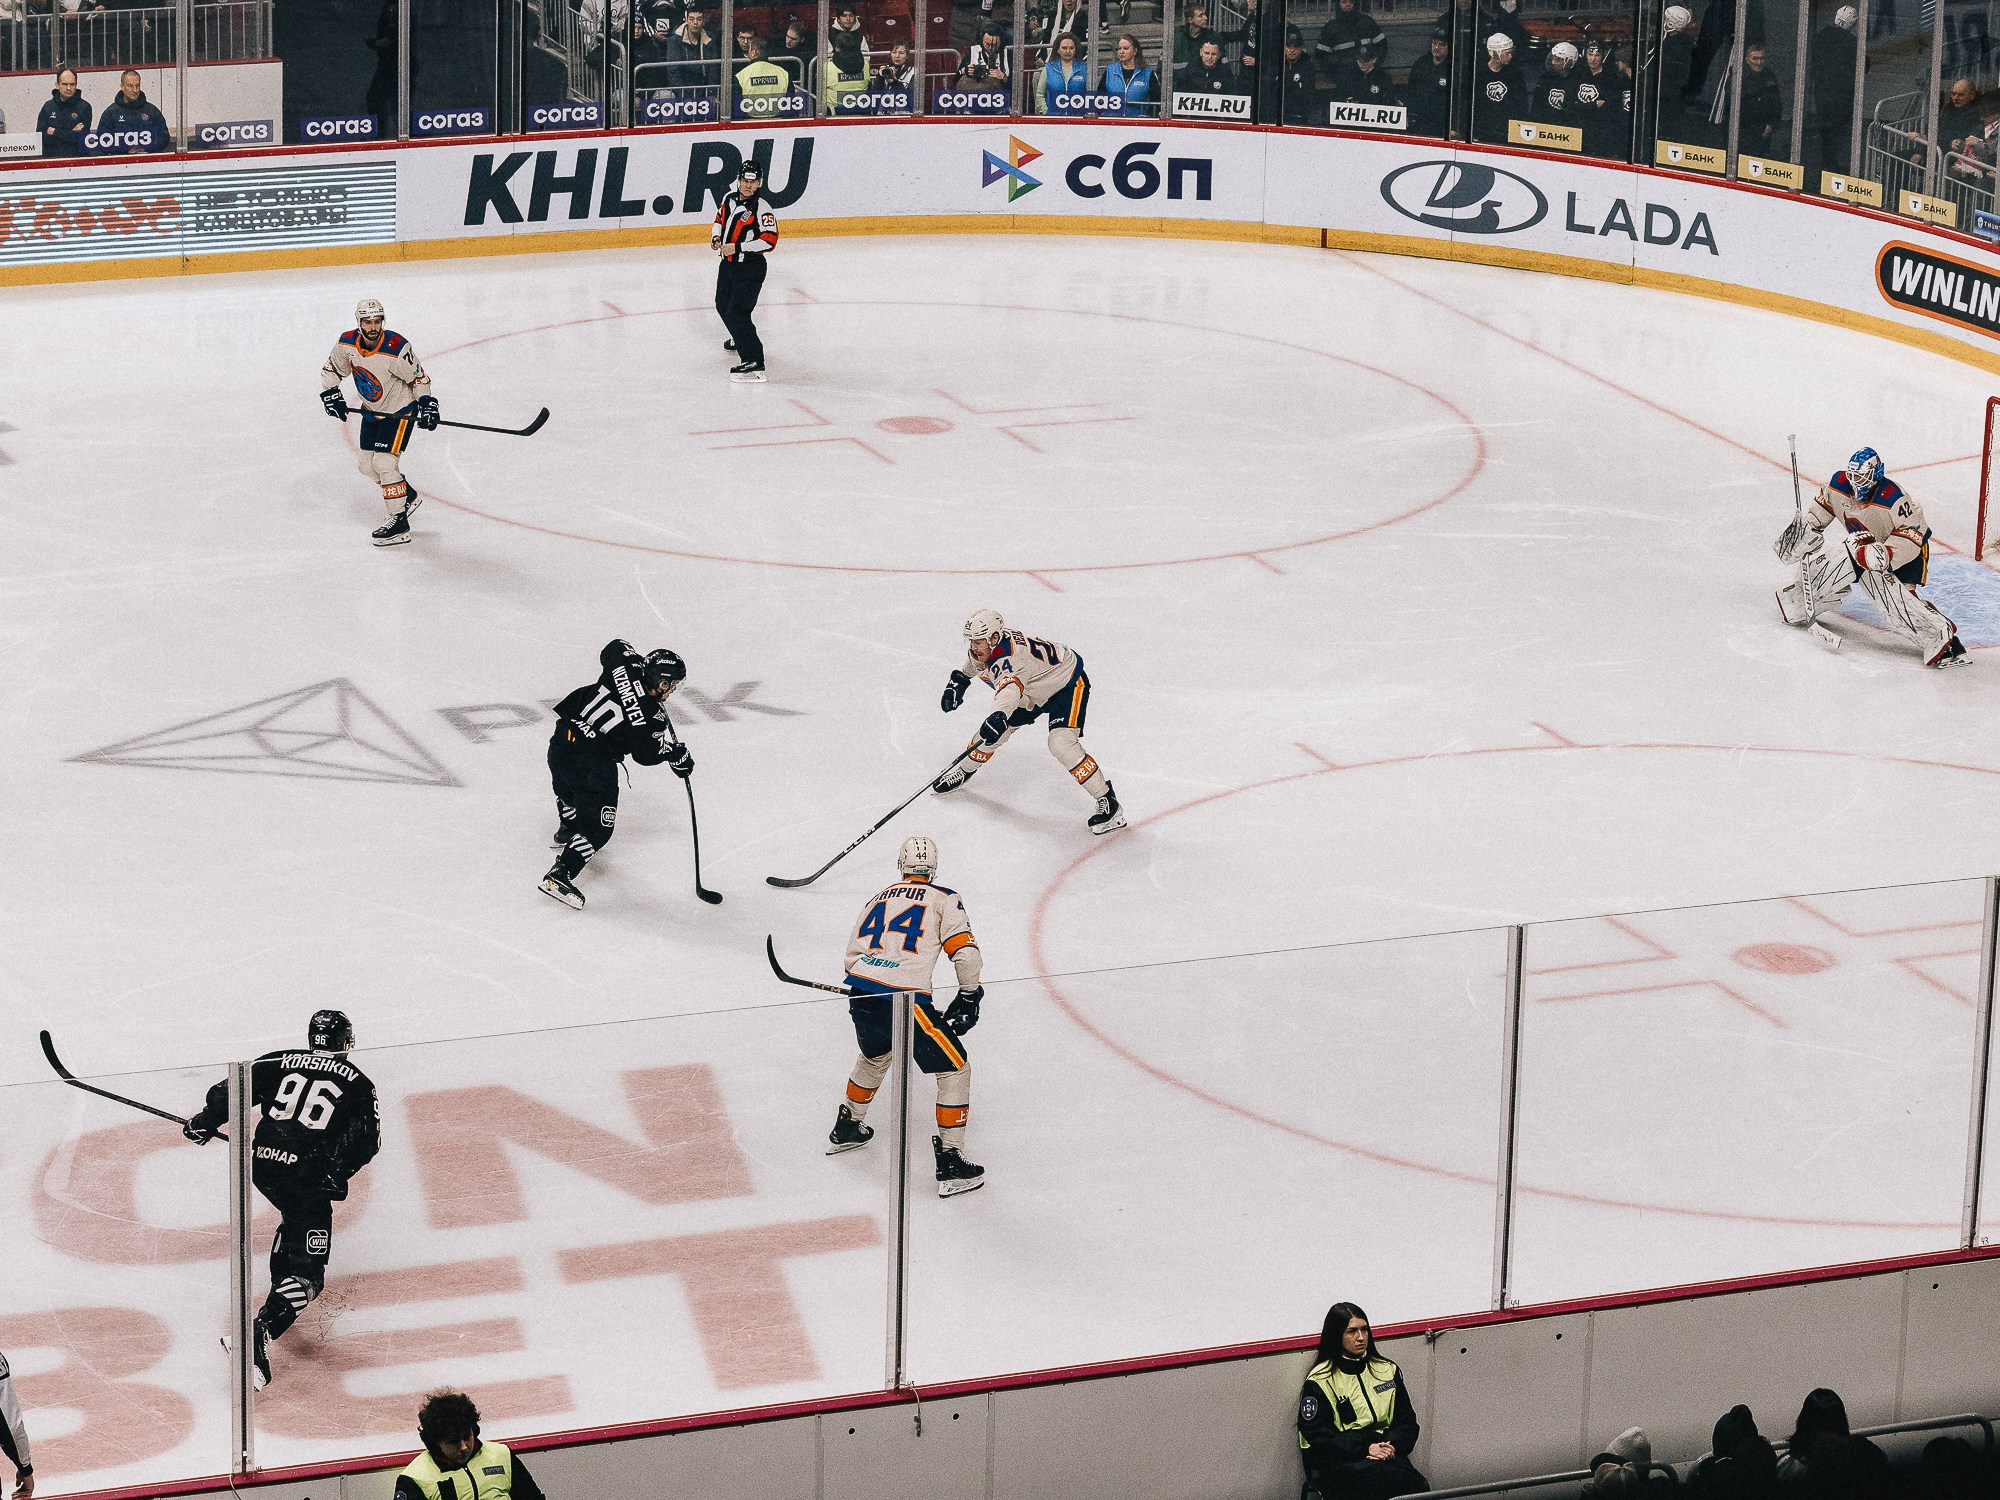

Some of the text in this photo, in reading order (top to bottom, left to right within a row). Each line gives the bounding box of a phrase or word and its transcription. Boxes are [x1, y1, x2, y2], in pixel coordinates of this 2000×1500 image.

[646, 100, 710, 118] согаз
[740, 95, 804, 114] согаз
[842, 93, 908, 109] согаз
[938, 92, 1005, 109] согаз
[1056, 93, 1122, 110] согаз
[1178, 96, 1246, 114] KHL.RU
[418, 112, 483, 130] согаз
[533, 105, 598, 124] согаз
[1335, 106, 1402, 125] KHL.RU
[201, 124, 268, 143] согаз
[305, 118, 372, 137] согаз
[84, 130, 152, 149] согаз
[1539, 131, 1570, 143] БАНК
[1685, 152, 1715, 164] БАНК
[1065, 141, 1213, 200] сбп
[1765, 167, 1793, 179] БАНК
[463, 137, 815, 226] KHL.RU
[1847, 183, 1873, 197] БАНК
[1923, 203, 1947, 217] БАНК
[763, 215, 774, 226] 25
[1565, 191, 1719, 256] LADA
[1892, 255, 2000, 324] WINLIN
[1897, 501, 1913, 519] 42
[1011, 630, 1027, 648] REIL
[612, 665, 647, 727] NIZAMEYEV
[580, 684, 625, 735] 10
[915, 851, 927, 860] 44
[871, 887, 927, 903] ARPUR
[857, 899, 928, 955] 44
[315, 1034, 326, 1045] 96
[280, 1053, 360, 1082] KORSHKOV
[268, 1072, 344, 1130] 96
